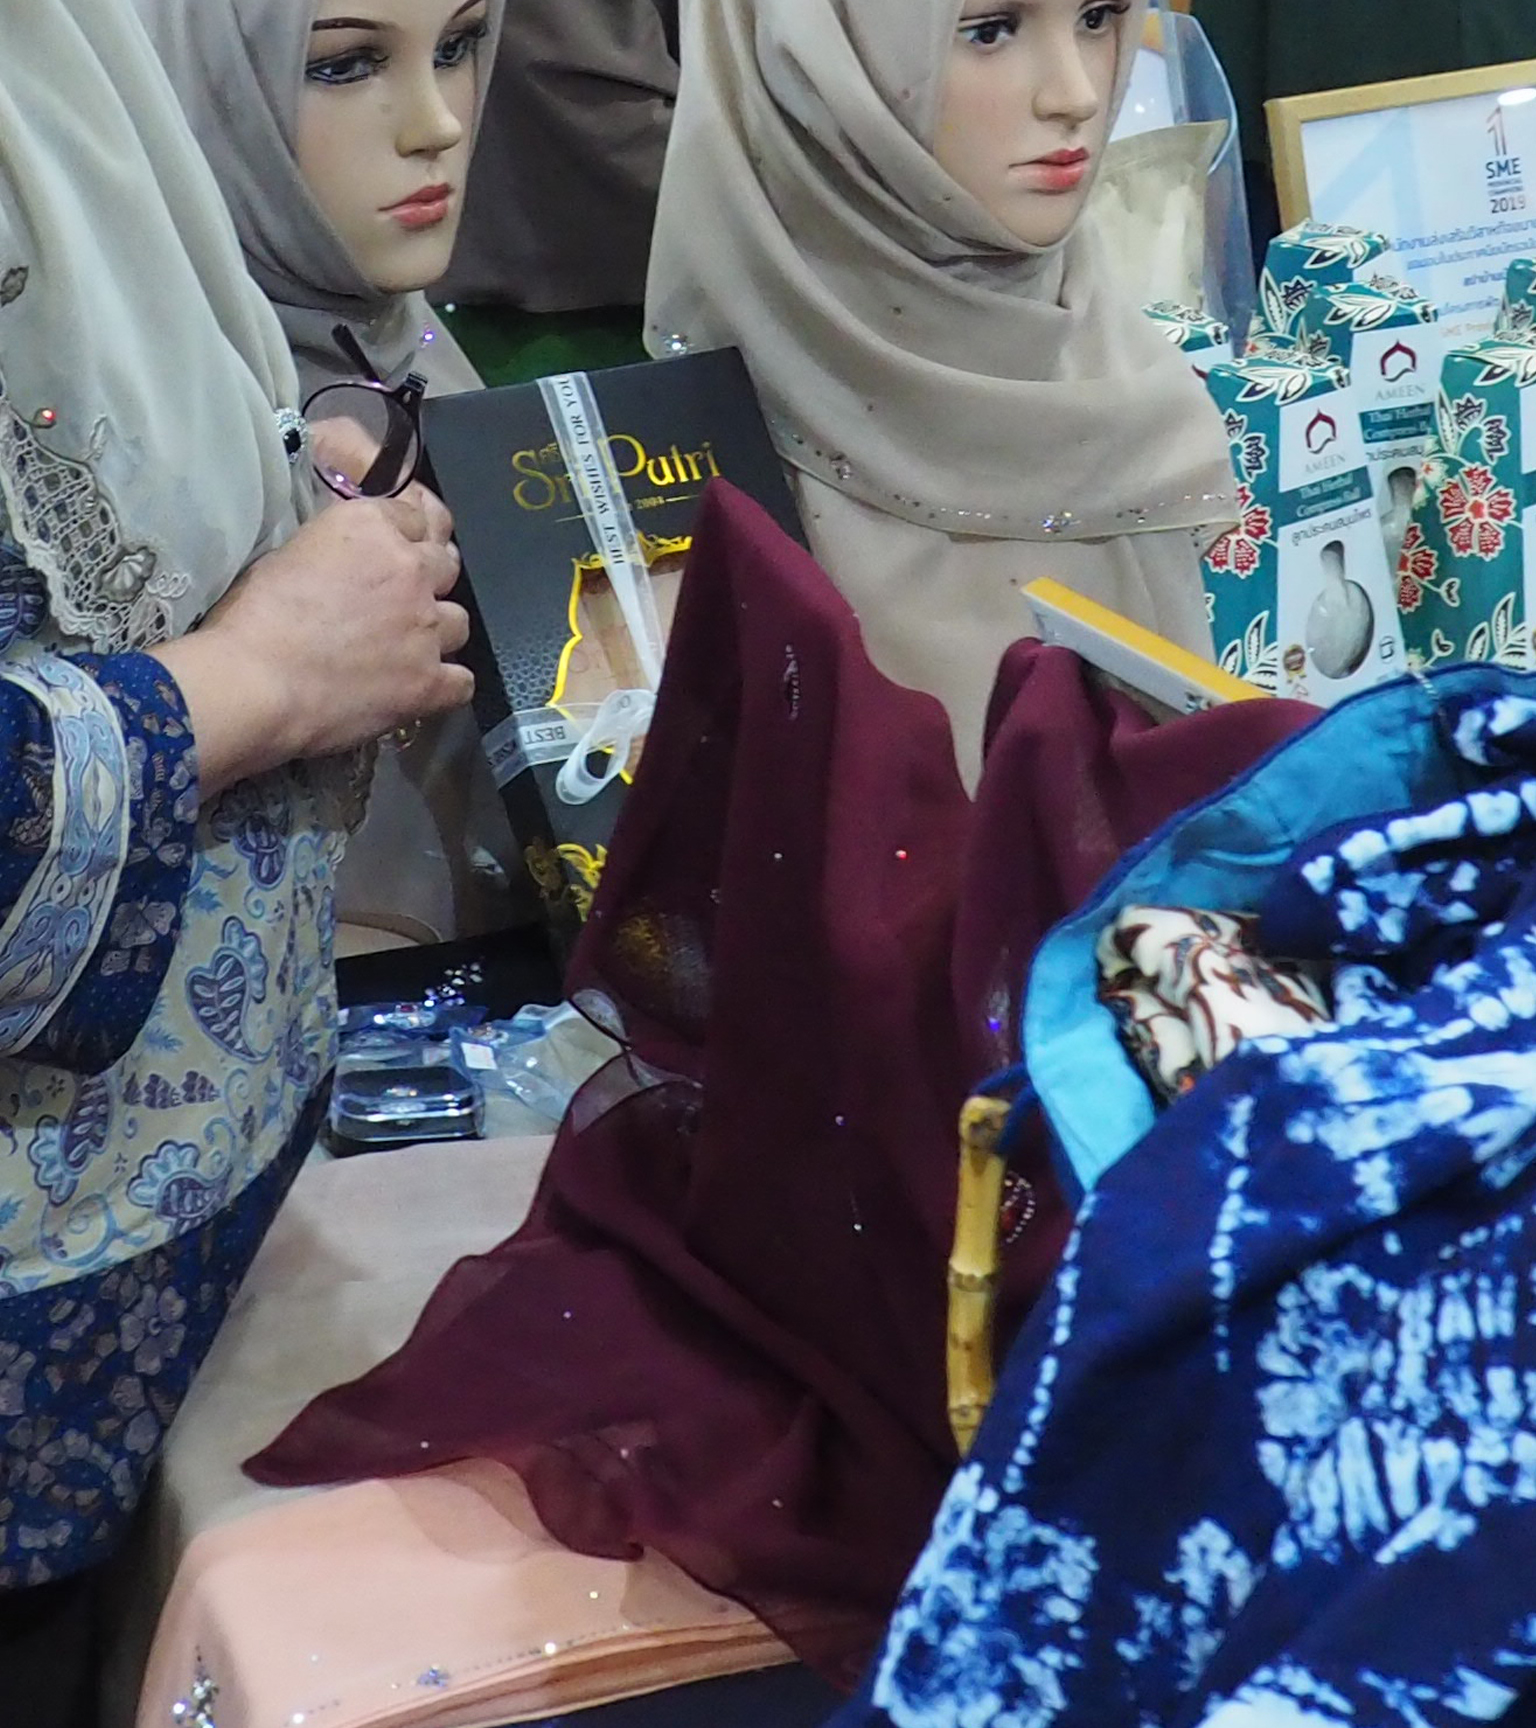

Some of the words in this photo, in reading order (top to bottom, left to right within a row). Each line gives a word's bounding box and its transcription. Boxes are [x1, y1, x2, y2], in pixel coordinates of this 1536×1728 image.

[1485, 157, 1522, 179] SME
[1489, 194, 1526, 214] 2019
[571, 415, 589, 445] FOR
